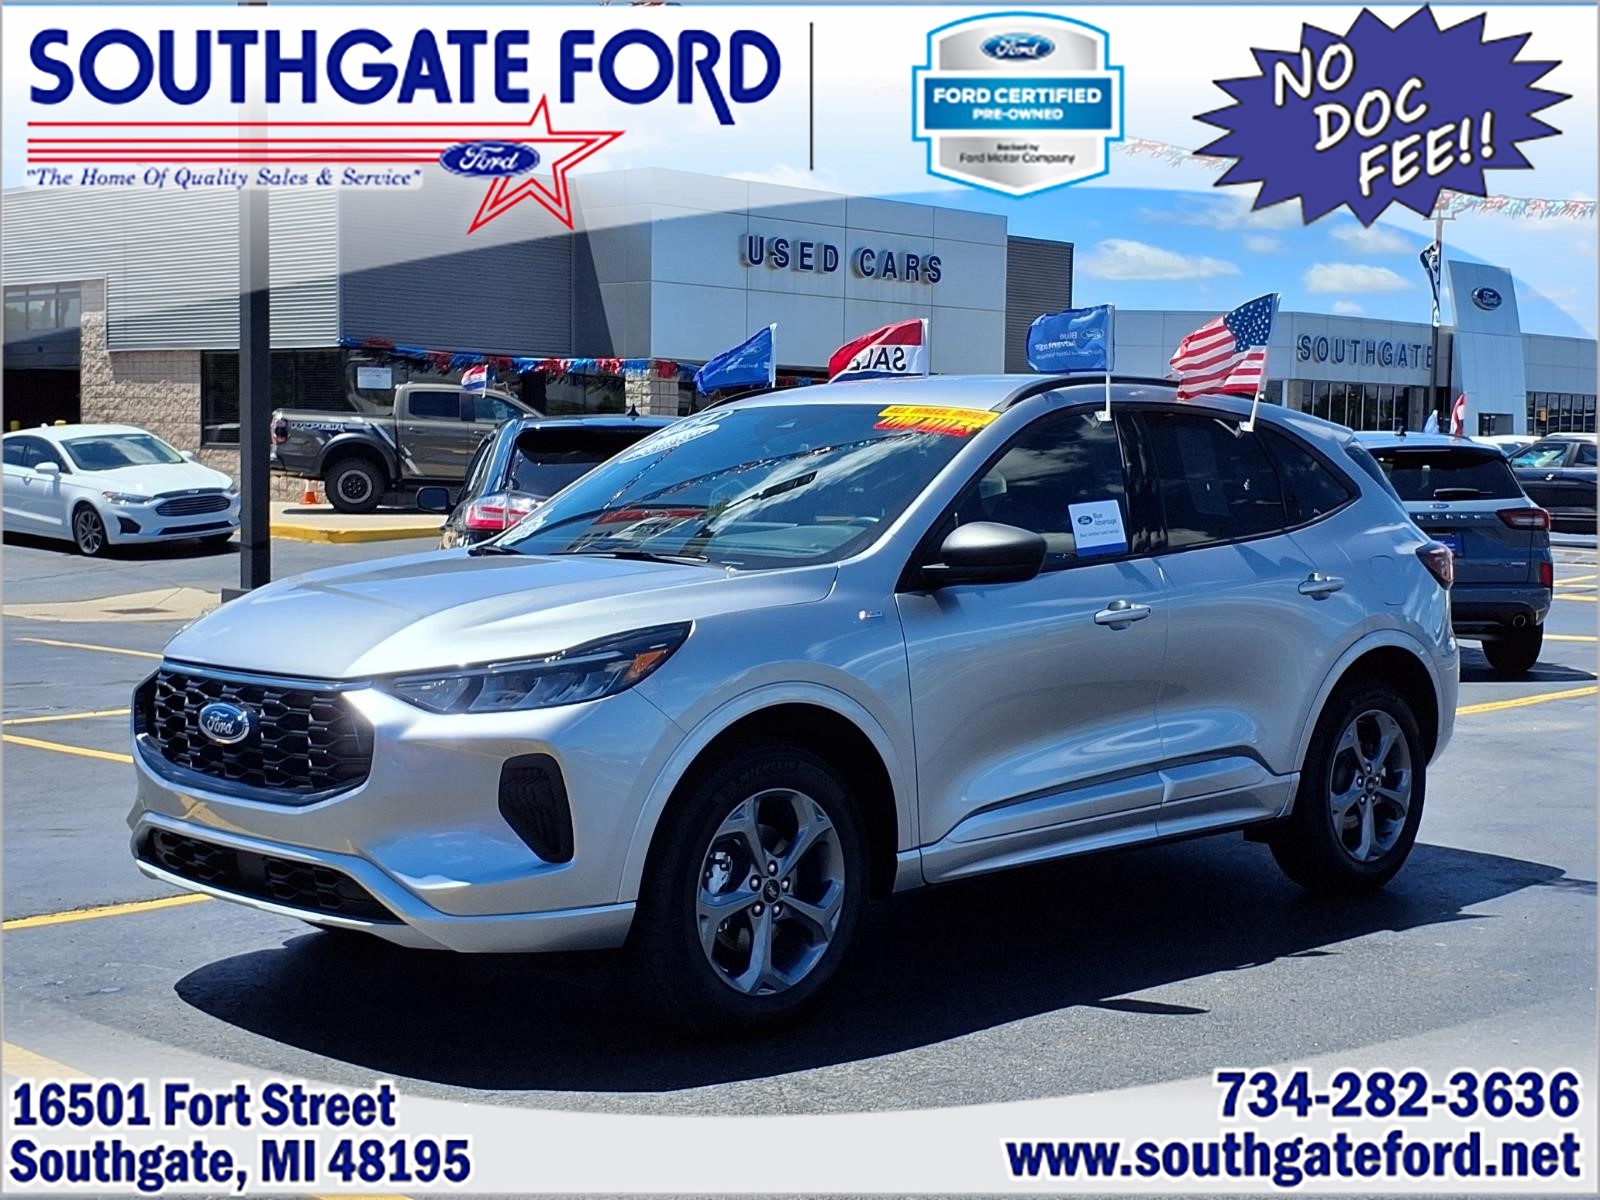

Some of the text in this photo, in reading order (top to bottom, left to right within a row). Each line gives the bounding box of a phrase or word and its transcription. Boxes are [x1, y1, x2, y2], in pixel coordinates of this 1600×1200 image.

[744, 234, 943, 285] USED CARS
[1298, 334, 1433, 371] SOUTHGATE
